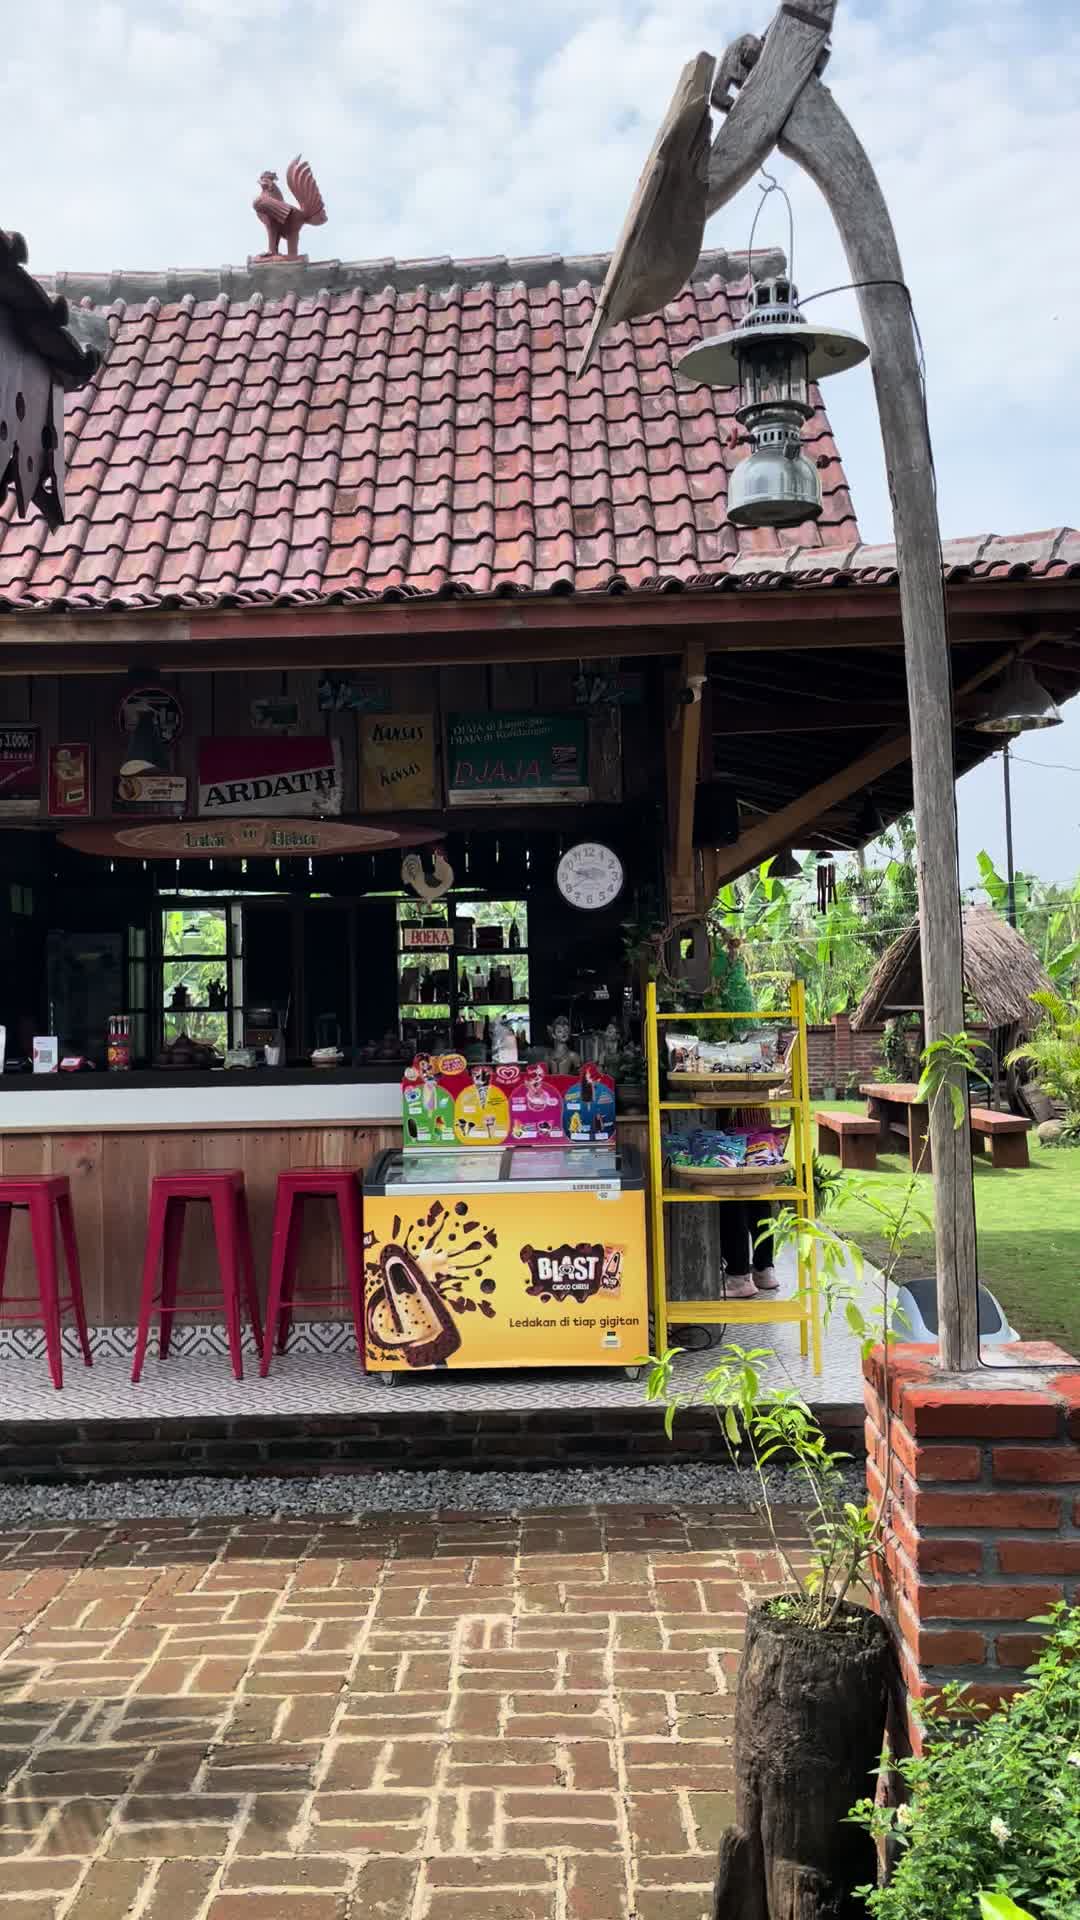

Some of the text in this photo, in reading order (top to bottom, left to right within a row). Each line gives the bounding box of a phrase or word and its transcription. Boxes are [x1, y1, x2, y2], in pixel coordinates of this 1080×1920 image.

[455, 760, 542, 784] DJAJA
[204, 767, 336, 807] ARDATH
[583, 848, 594, 857] 12
[410, 929, 449, 945] BOEKA
[537, 1255, 599, 1282] BLAST
[552, 1283, 571, 1291] CHOCO
[509, 1315, 640, 1329] Ledakan di tiap gigitan
